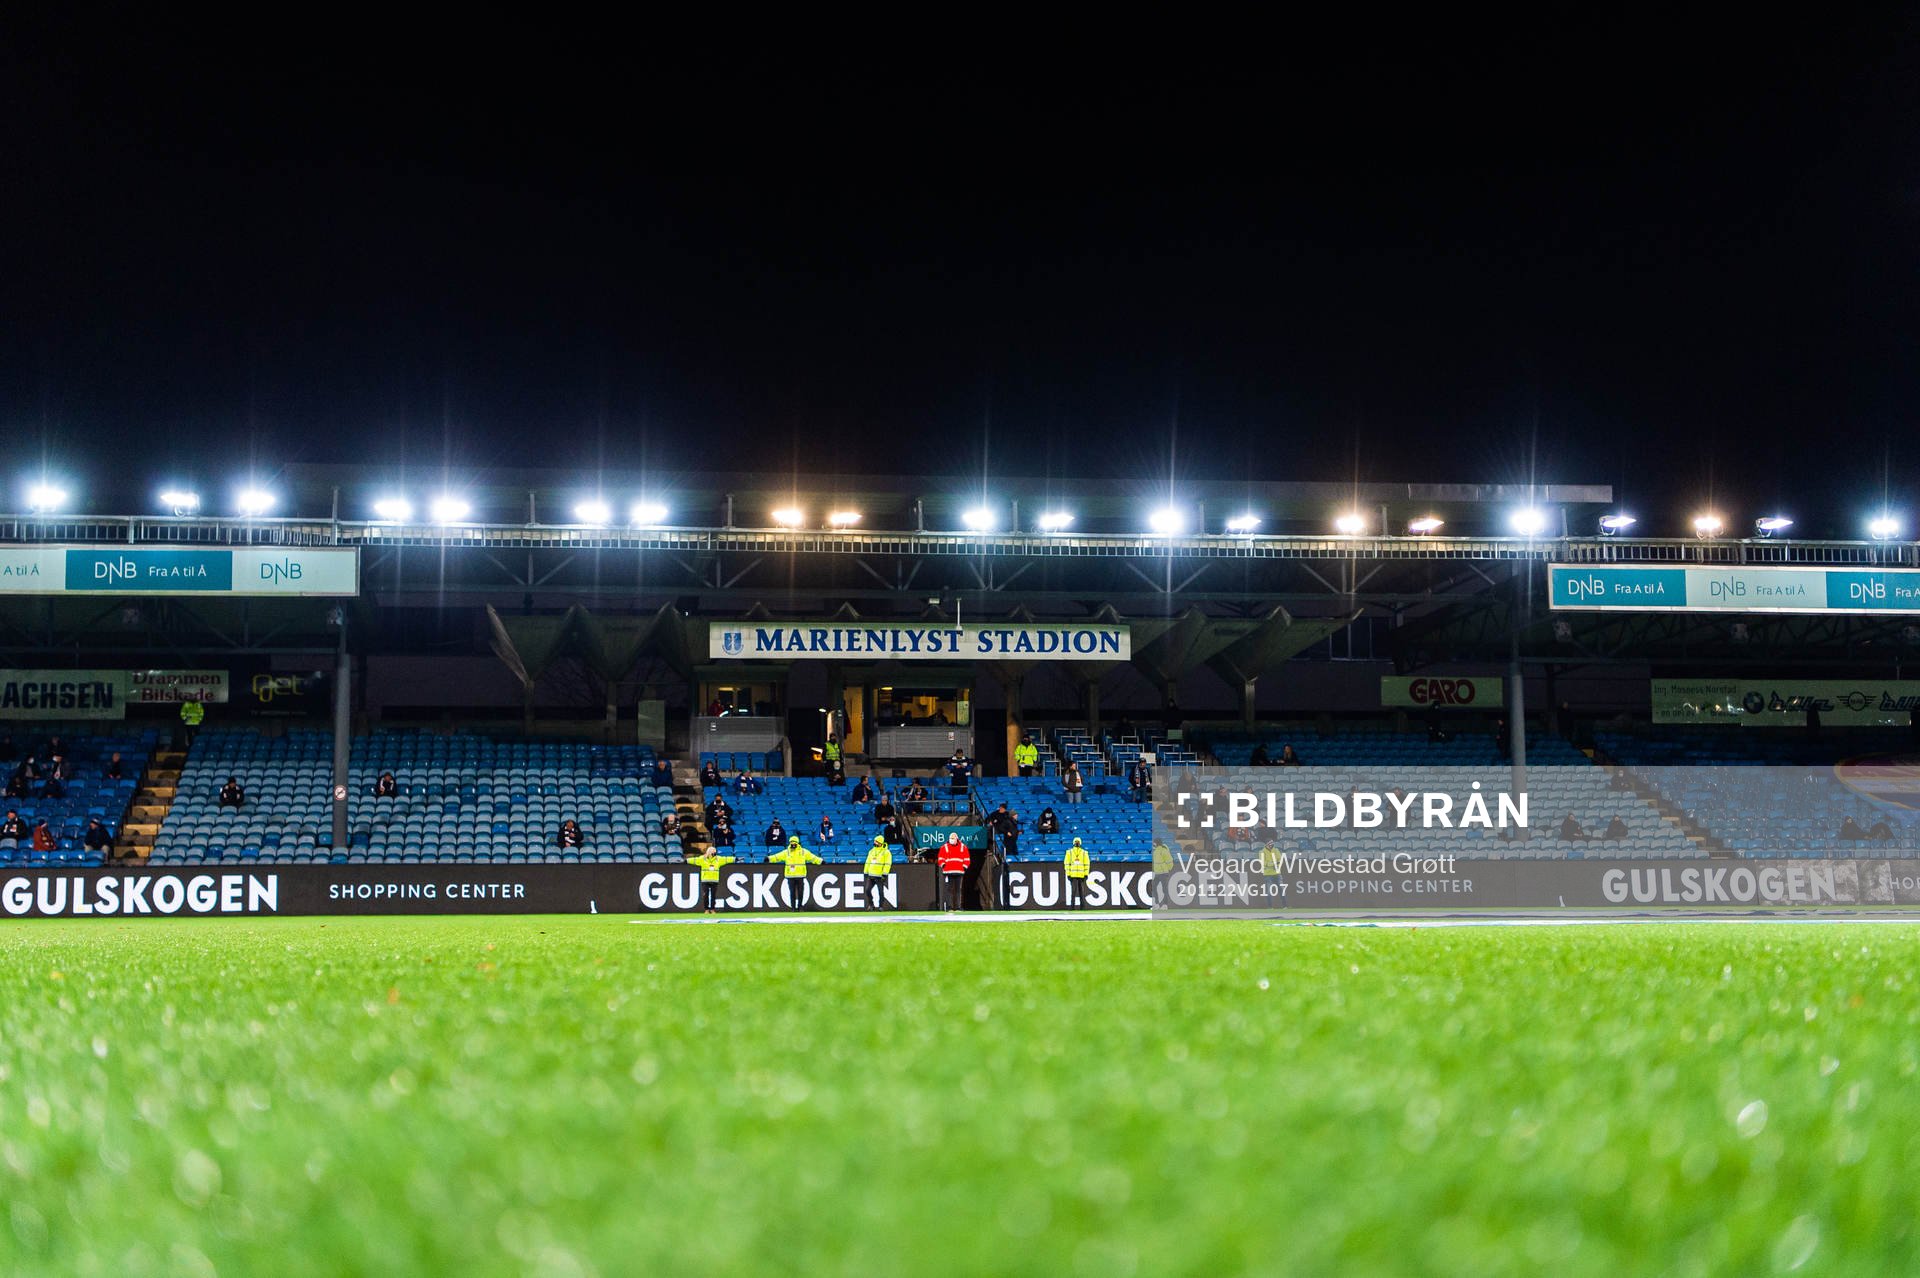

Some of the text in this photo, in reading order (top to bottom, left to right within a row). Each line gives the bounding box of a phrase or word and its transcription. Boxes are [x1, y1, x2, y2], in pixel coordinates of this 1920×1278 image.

[4, 565, 12, 576] A
[16, 565, 27, 576] til
[94, 556, 207, 584] DNB Fra A til Å
[260, 557, 302, 584] DNB
[1568, 574, 1664, 600] DNB Fra A til Å
[1710, 576, 1805, 601] DNB Fra A til Å
[1850, 578, 1886, 603] DNB
[1895, 587, 1912, 598] Fra
[755, 628, 1121, 654] MARIENLYST STADION
[2, 682, 113, 708] ACHSEN
[1409, 679, 1475, 704] GARO
[922, 830, 945, 846] DNB
[2, 874, 279, 914] GULSKOGEN
[329, 884, 526, 898] SHOPPING CENTER
[1295, 879, 1473, 893] SHOPPING CENTER
[1601, 867, 1837, 902] GULSKOGEN
